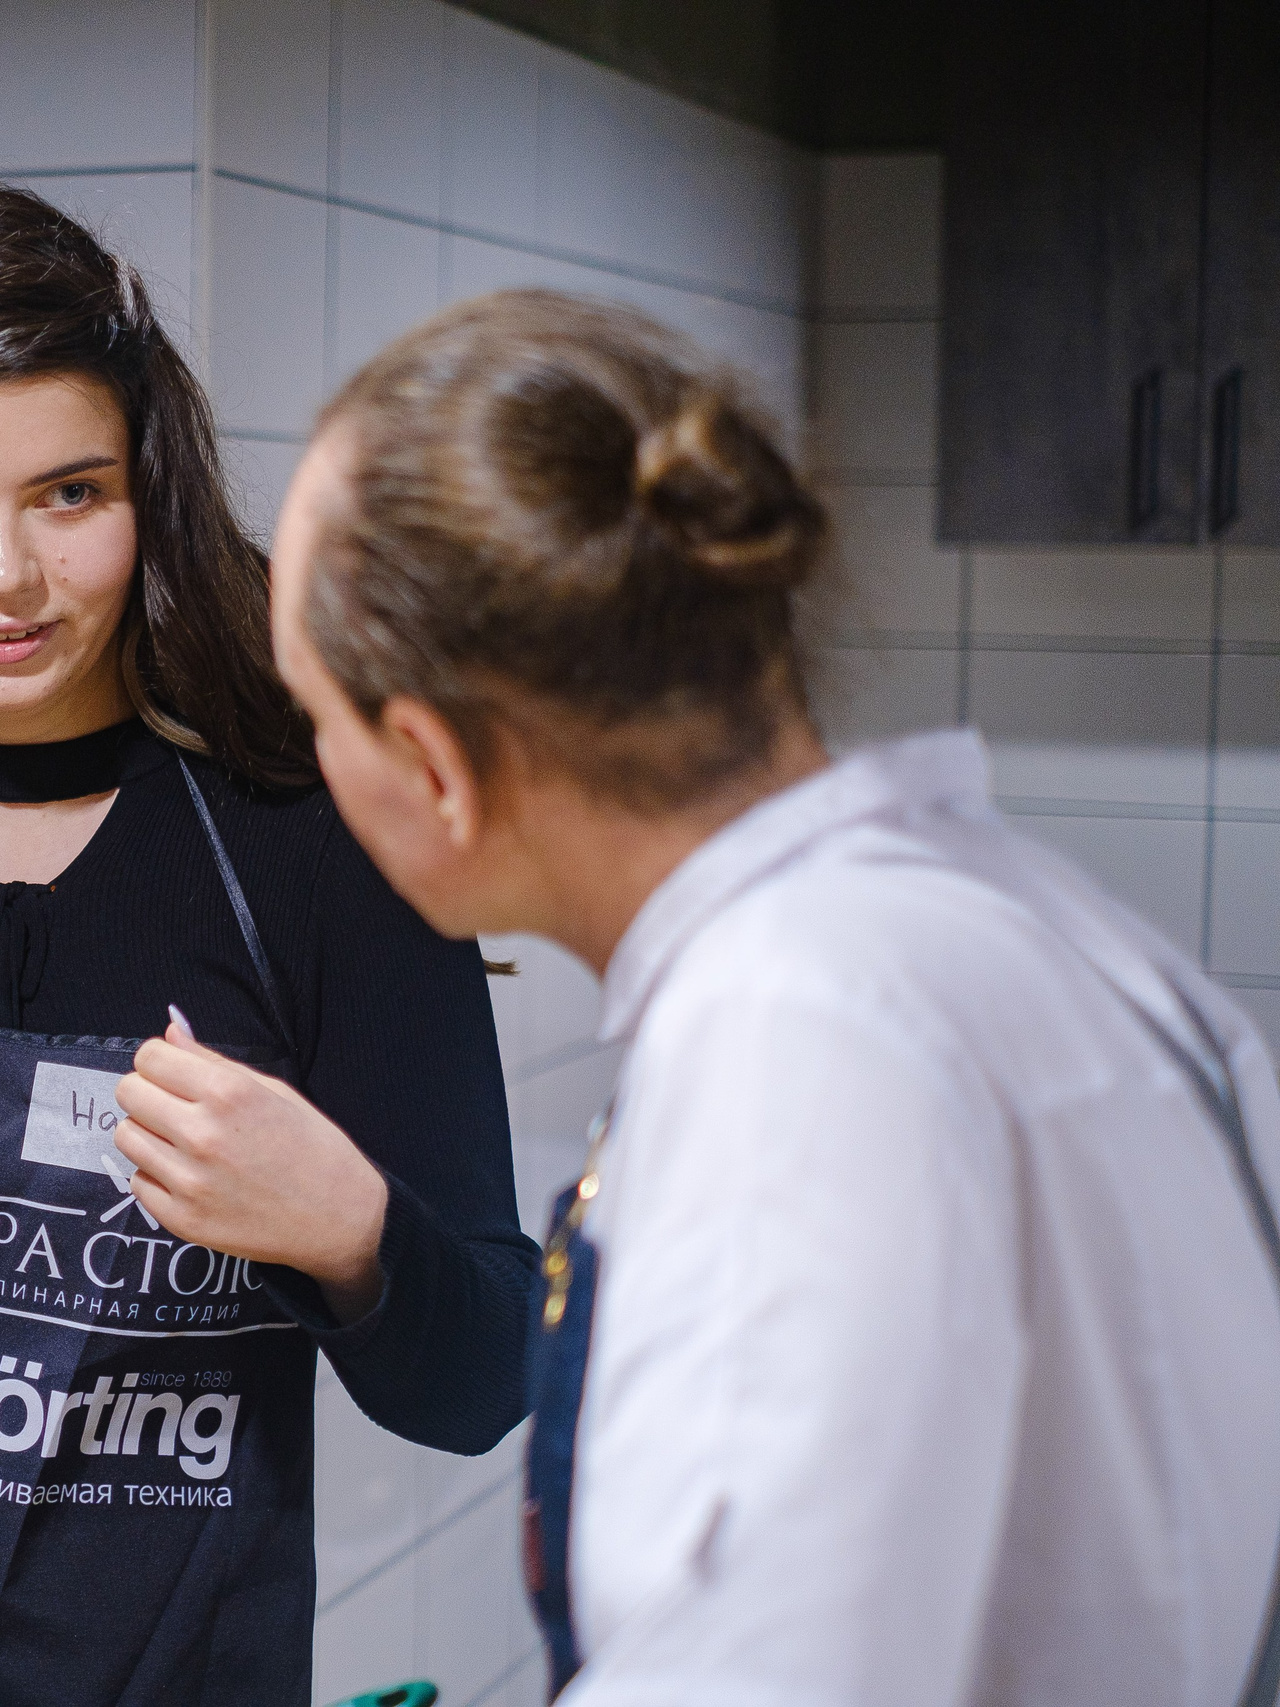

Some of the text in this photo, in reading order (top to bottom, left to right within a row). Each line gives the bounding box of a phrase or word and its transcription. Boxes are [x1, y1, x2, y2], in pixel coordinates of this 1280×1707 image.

[83, 1231, 264, 1296] СТОЛ
[155, 1303, 241, 1324] СТУДИЯ
[140, 1369, 232, 1388] since 1889
[124, 1482, 232, 1507] техника
